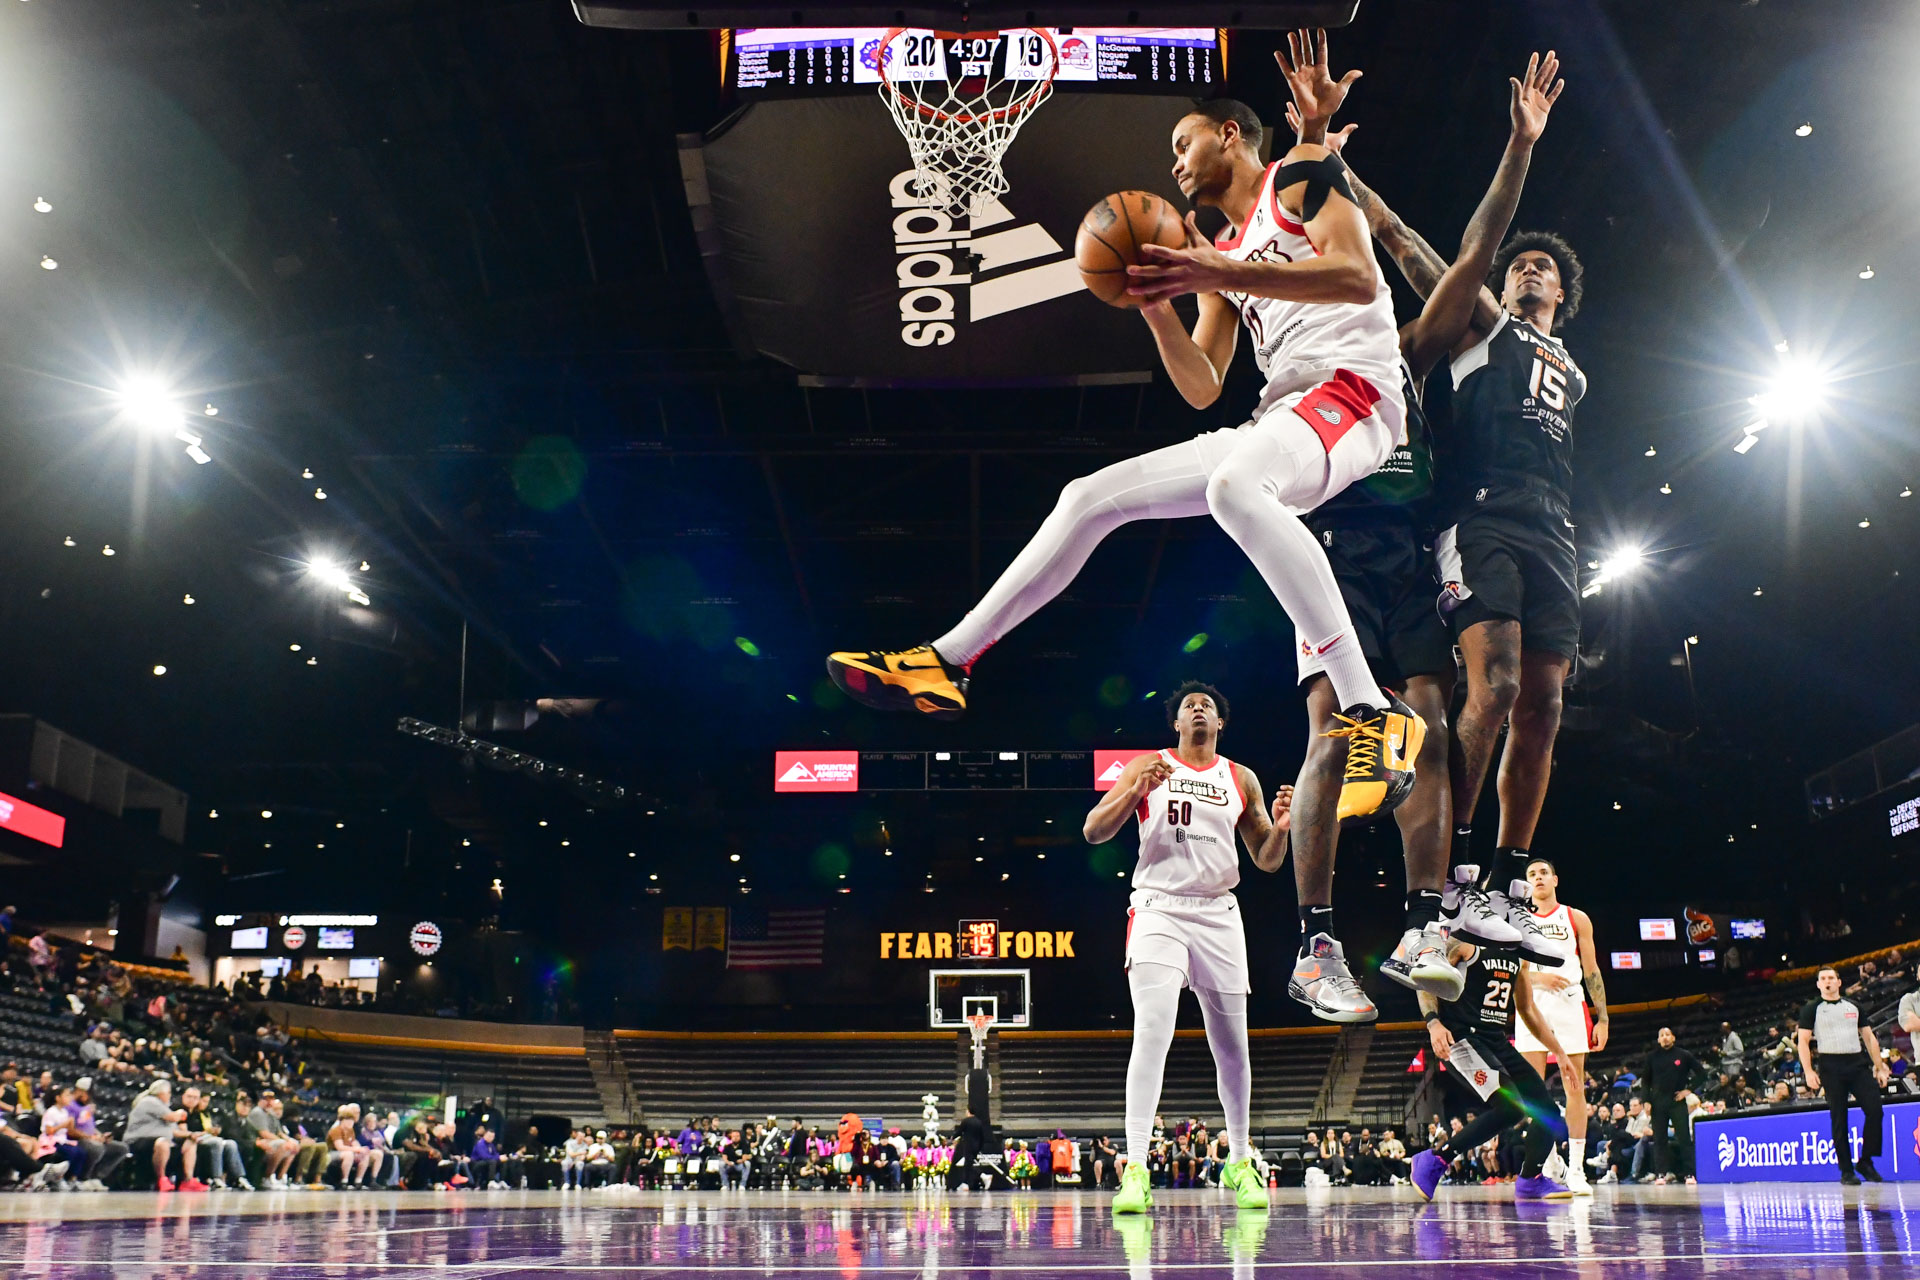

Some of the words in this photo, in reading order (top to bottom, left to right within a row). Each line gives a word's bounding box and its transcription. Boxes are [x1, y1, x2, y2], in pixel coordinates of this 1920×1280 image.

[905, 36, 936, 66] 20
[950, 38, 1000, 58] 4:07
[1018, 36, 1043, 66] 19
[1098, 44, 1141, 52] McGowens
[1099, 59, 1127, 67] Manley
[888, 168, 972, 347] adidas
[1529, 358, 1567, 411] 15
[1538, 408, 1568, 430] RIVER
[1169, 779, 1227, 801] Remix
[1168, 800, 1192, 826] 50
[1897, 797, 1920, 814] DEFENS
[1186, 833, 1217, 843] BRIGHTSIDE
[969, 923, 995, 935] 4:07
[1690, 920, 1711, 936] BIG
[880, 932, 952, 959] FEAR
[973, 936, 992, 956] 15
[999, 931, 1075, 958] FORK
[1482, 958, 1519, 974] VALLEY
[1483, 980, 1512, 1009] 23
[1736, 1136, 1799, 1167] Banner
[1801, 1126, 1864, 1165] Heah
